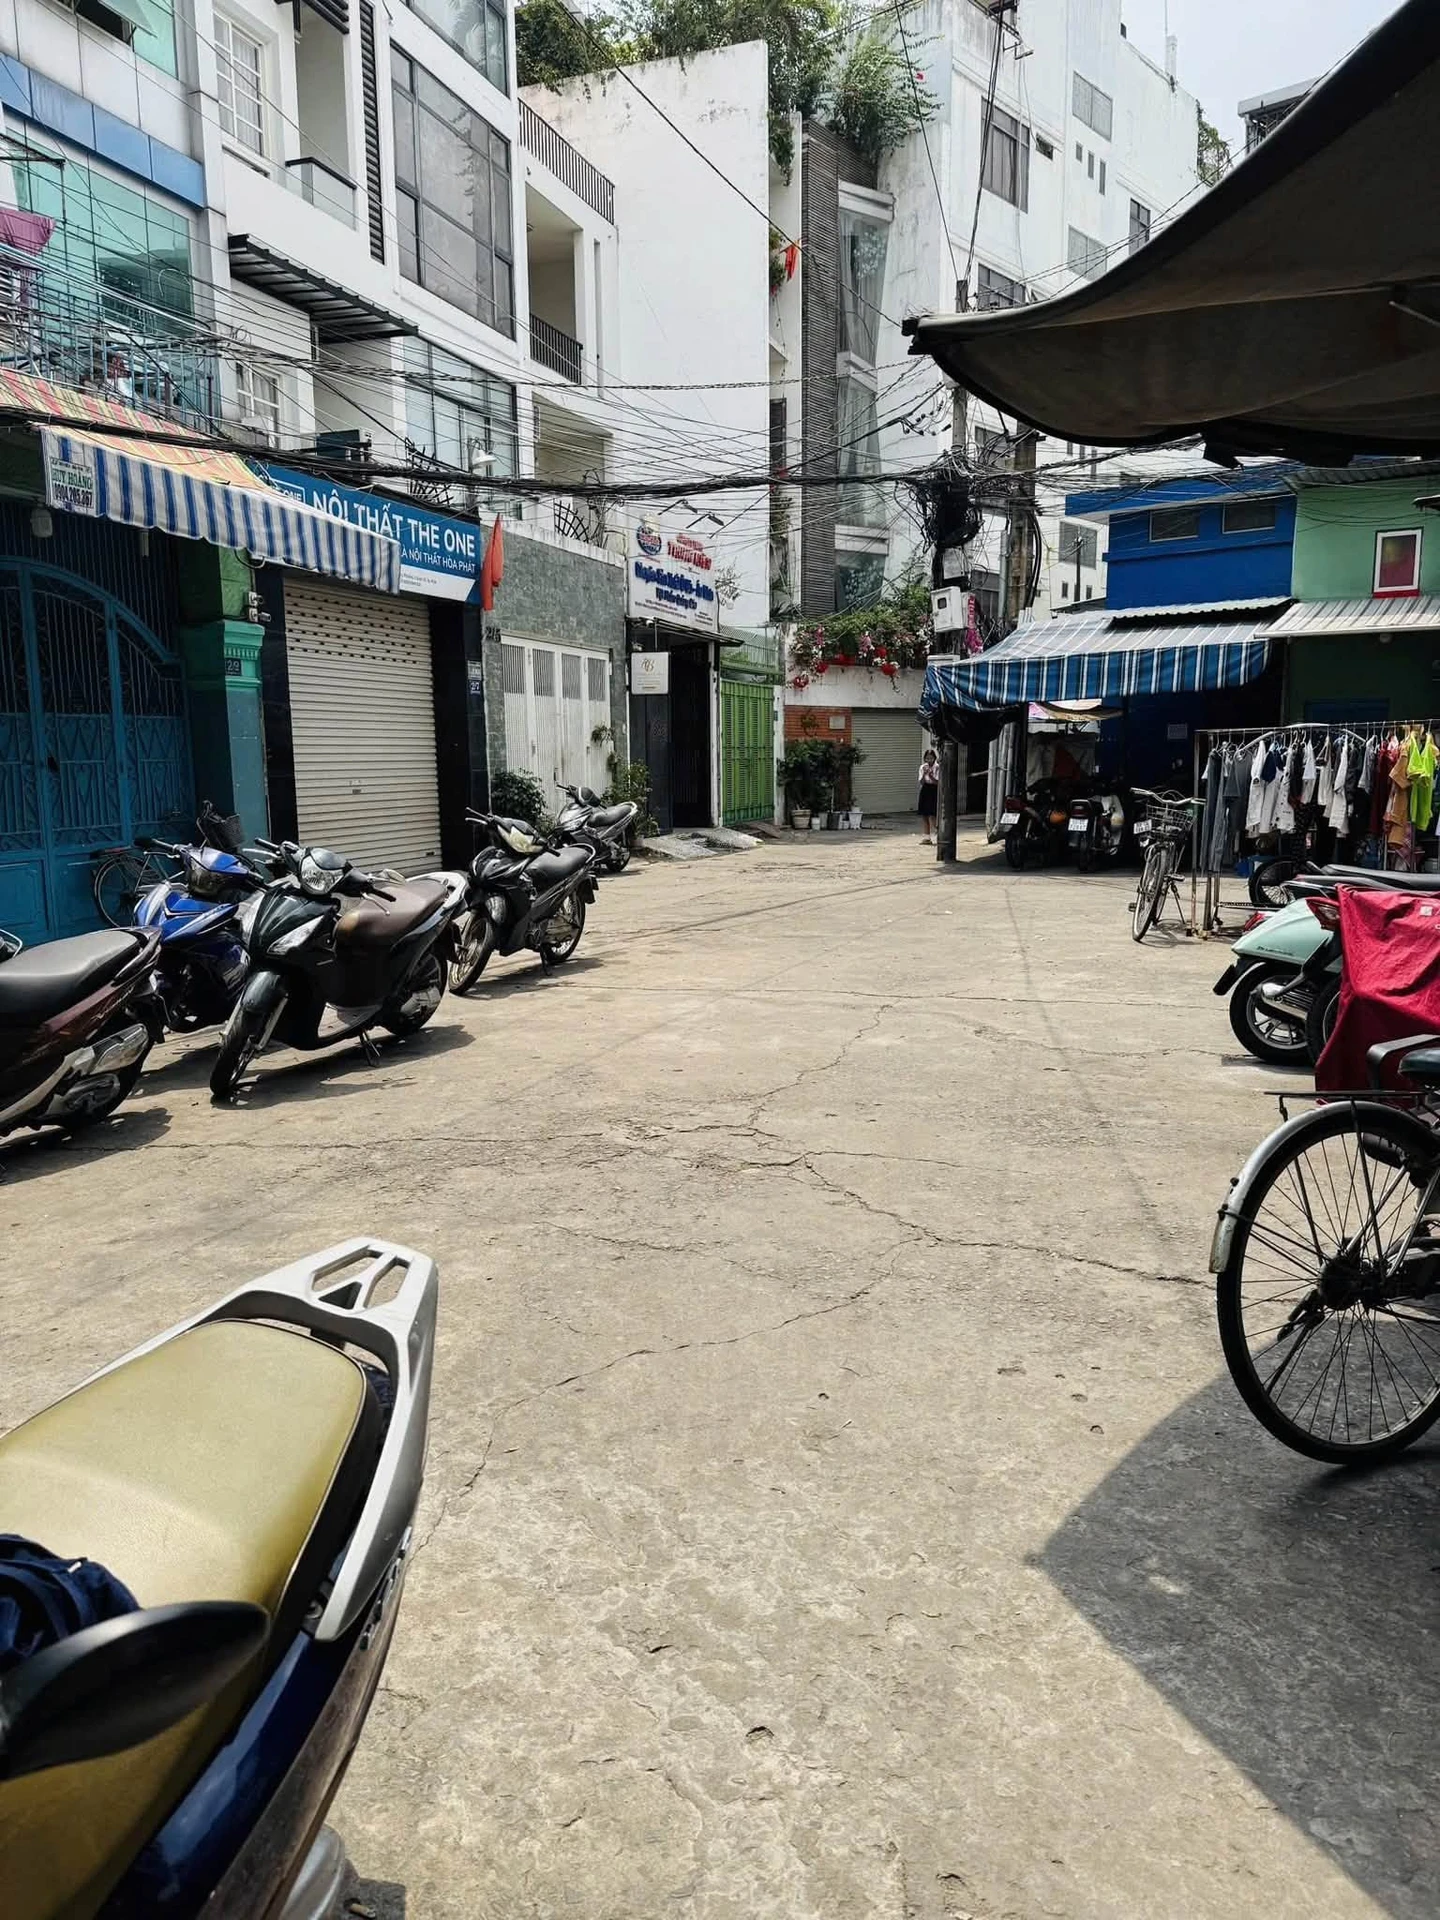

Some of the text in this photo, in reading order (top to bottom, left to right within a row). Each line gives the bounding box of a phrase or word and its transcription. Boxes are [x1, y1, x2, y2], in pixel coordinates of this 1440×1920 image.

[354, 503, 403, 539] THẤT
[408, 518, 440, 549] THE
[444, 528, 476, 557] ONE
[423, 552, 441, 565] THẤT
[442, 555, 458, 569] HÒA
[458, 560, 476, 573] PHÁT
